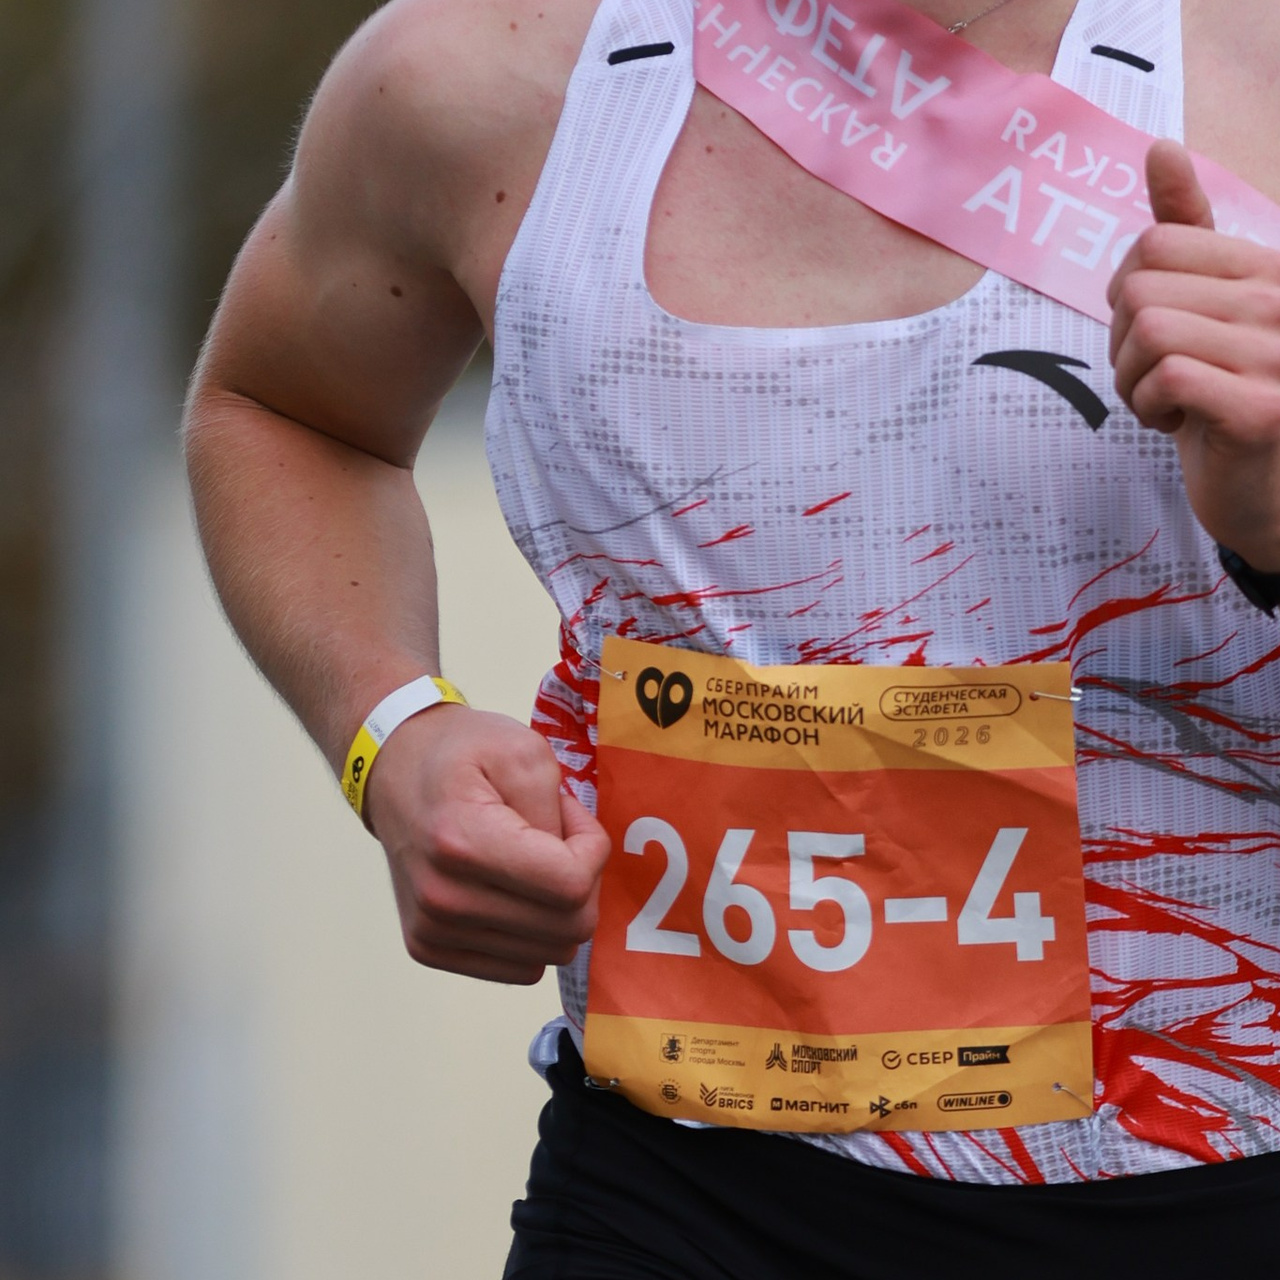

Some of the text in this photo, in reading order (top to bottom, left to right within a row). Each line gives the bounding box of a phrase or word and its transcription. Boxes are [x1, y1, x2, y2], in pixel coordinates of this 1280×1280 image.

[706, 677, 818, 700] СБЕРПРАЙМ
[893, 688, 1007, 704] СТУДЕНЧЕСКАЯ
[702, 696, 865, 726] МОСКОВСКИЙ
[893, 703, 968, 716] ЭСТАФЕТА
[703, 719, 820, 746] МАРАФОН
[912, 724, 991, 748] 2026
[623, 816, 1056, 972] 265-4
[690, 1037, 740, 1047] Департамент
[690, 1048, 716, 1056] спорта
[791, 1044, 858, 1062] МОСКОВСКИЙ
[907, 1051, 1000, 1065] СБЕР Прайм
[689, 1057, 745, 1067] города Москвы
[791, 1060, 821, 1074] СПОРТ
[718, 1098, 754, 1111] BRICS
[894, 1100, 918, 1110] сбп
[943, 1095, 996, 1108] WINLINE
